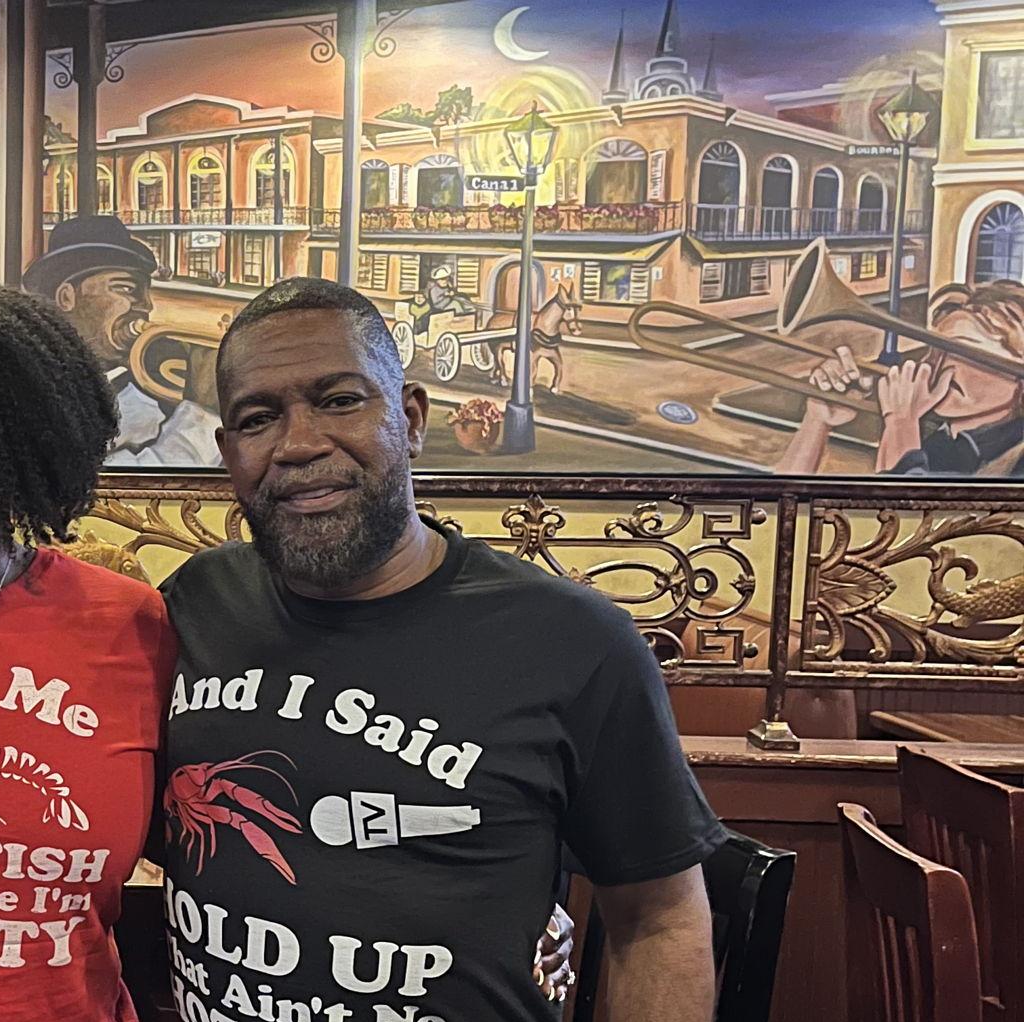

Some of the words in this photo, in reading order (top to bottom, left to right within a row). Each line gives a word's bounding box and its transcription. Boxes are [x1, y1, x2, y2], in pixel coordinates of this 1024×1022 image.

[471, 176, 518, 191] Canal
[168, 668, 264, 721] And
[277, 674, 315, 720] I
[325, 688, 483, 790] Said
[360, 800, 388, 841] TV
[32, 886, 92, 914] I'm
[328, 934, 454, 998] UP
